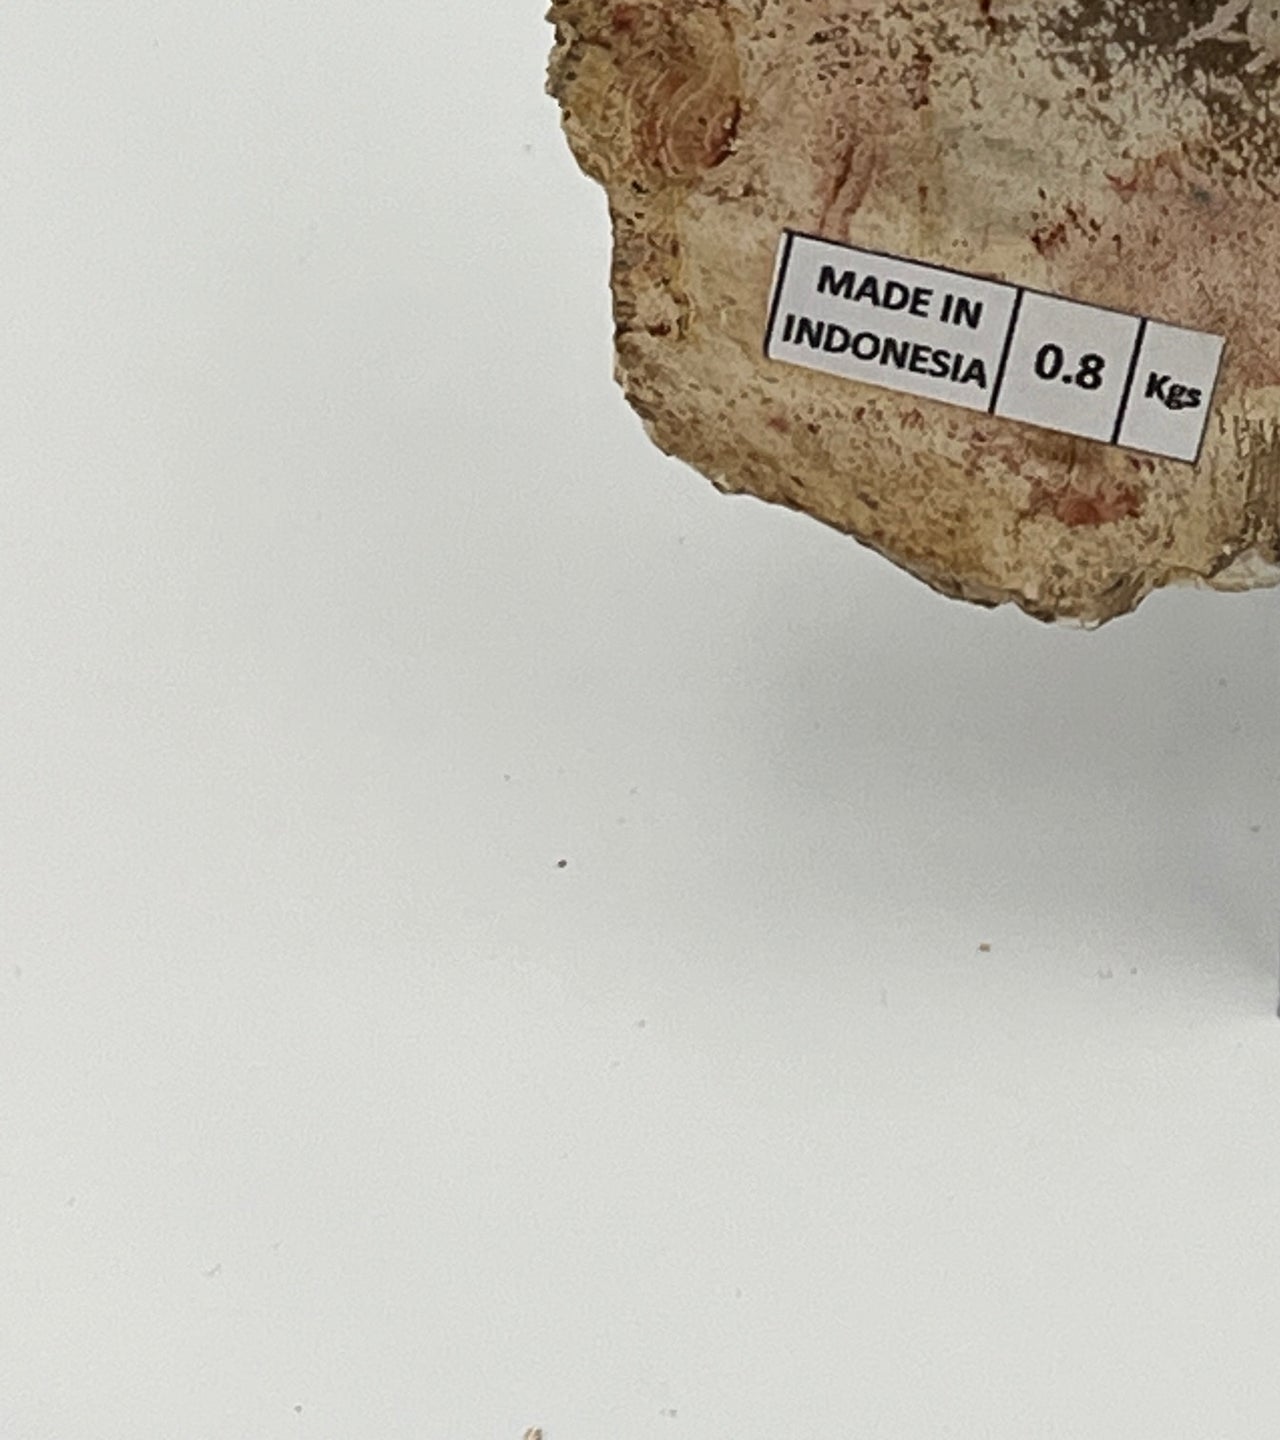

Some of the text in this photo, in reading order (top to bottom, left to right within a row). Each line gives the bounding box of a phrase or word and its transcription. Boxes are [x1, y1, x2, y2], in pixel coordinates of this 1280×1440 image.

[817, 265, 983, 329] MADE IN
[781, 313, 988, 389] INDONESIA
[1034, 342, 1202, 410] 0.8 Kgs
